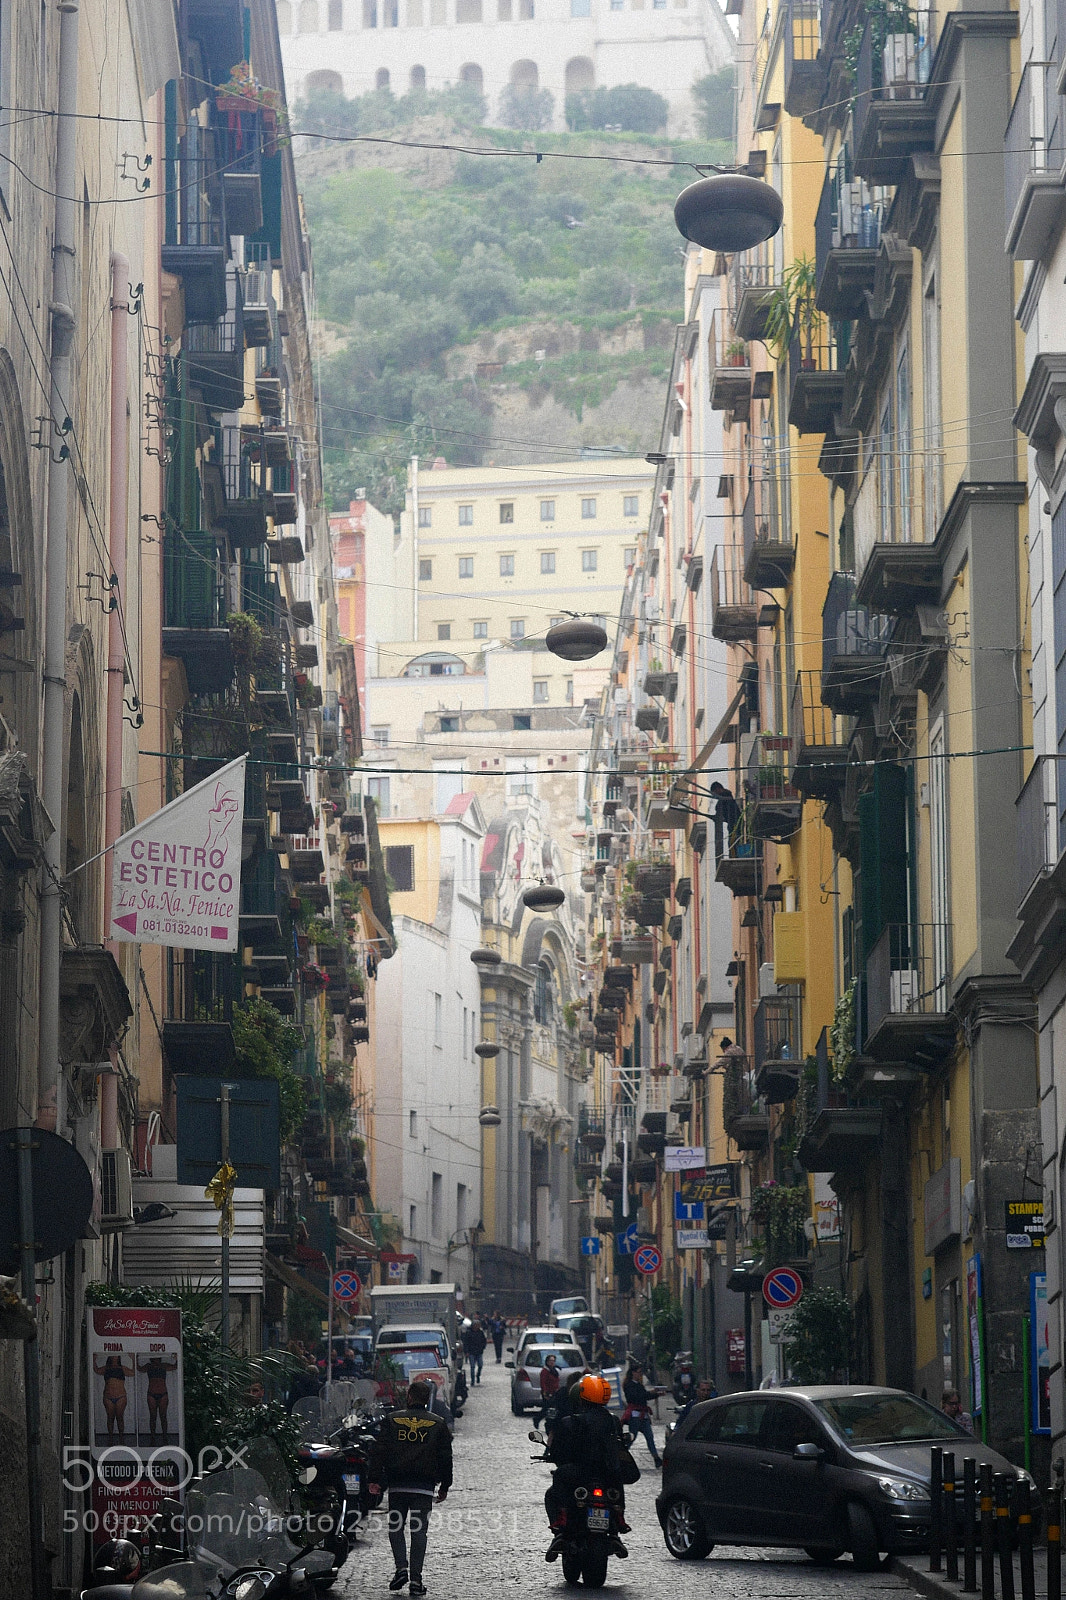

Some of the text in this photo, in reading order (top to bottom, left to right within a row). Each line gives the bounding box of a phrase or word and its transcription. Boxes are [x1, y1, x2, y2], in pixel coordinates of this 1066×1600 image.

[130, 839, 225, 869] CENTRO
[120, 862, 233, 893] ESTETICO
[142, 919, 209, 937] 081.0132401
[103, 1342, 166, 1352] PRIMA DOPO
[397, 1430, 428, 1443] BOY
[97, 1465, 131, 1478] METODO
[98, 1486, 175, 1497] FINO A 3 TAGLIE
[107, 1500, 118, 1511] IN
[120, 1500, 151, 1511] MENO
